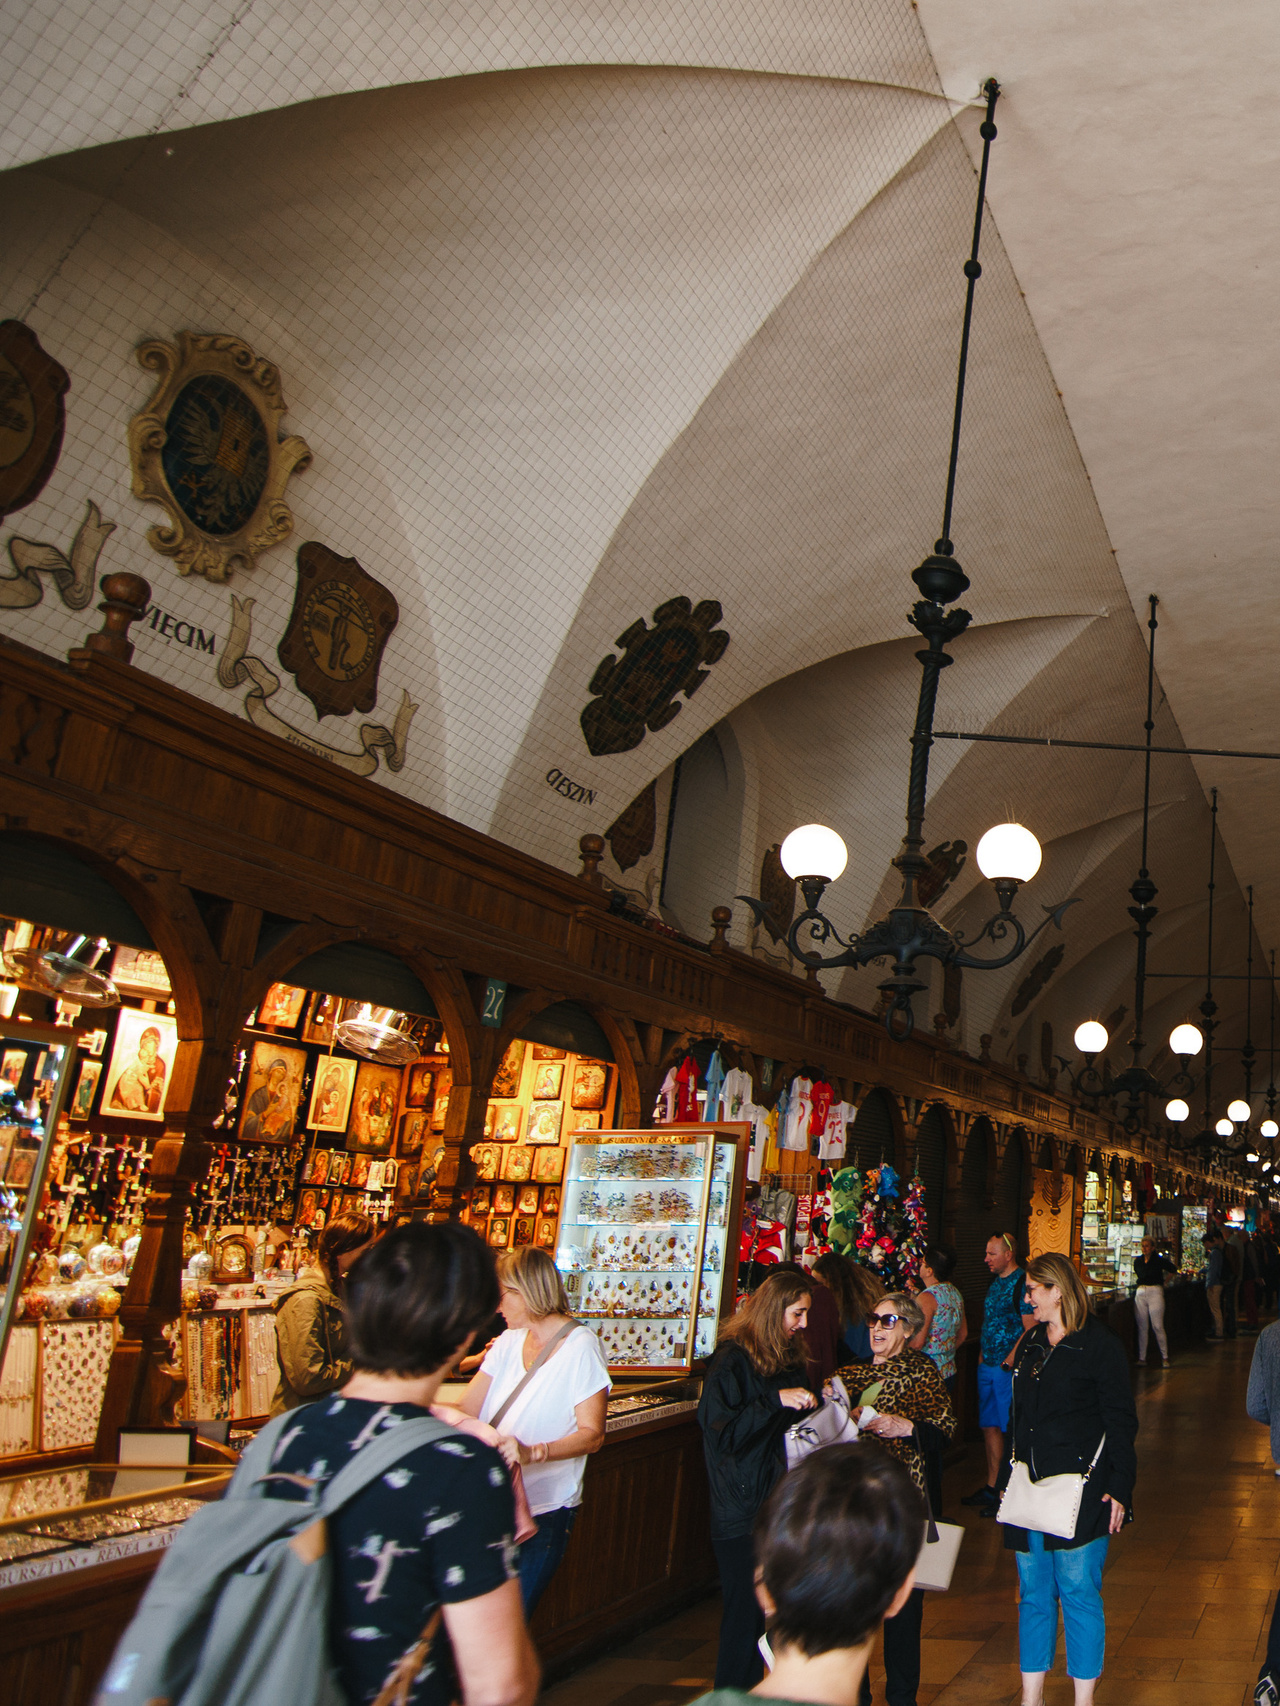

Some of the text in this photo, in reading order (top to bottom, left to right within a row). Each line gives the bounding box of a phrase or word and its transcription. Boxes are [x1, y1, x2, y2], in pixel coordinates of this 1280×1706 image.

[546, 768, 598, 806] CIESZYN
[483, 986, 506, 1020] 27
[96, 1541, 140, 1563] RENEA
